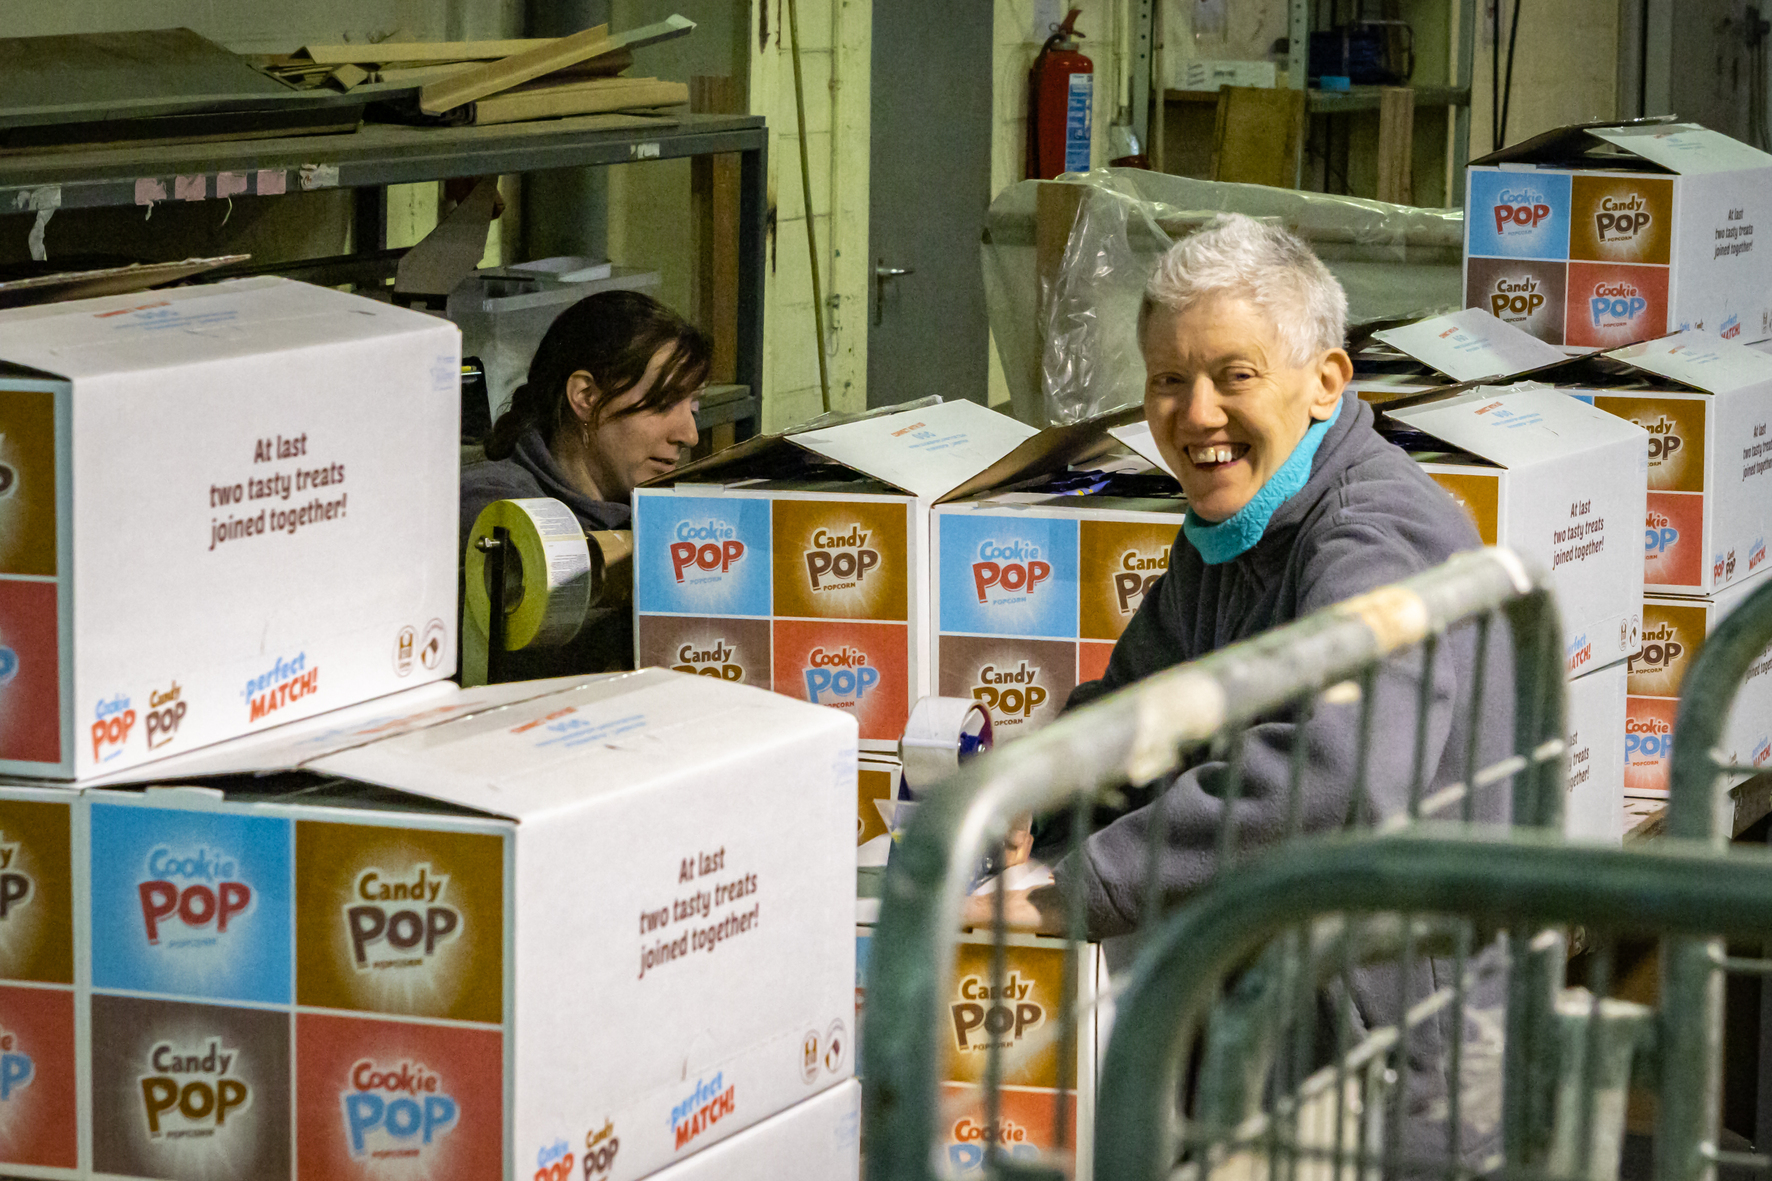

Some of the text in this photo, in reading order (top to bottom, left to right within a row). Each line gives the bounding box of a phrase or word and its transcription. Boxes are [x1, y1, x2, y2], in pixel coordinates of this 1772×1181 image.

[1499, 189, 1543, 205] Cookie
[1602, 195, 1643, 212] Candy
[1494, 204, 1550, 235] POP
[1595, 212, 1650, 242] POP
[1725, 226, 1738, 240] tasty
[1739, 224, 1753, 236] treats
[1714, 242, 1730, 260] joined
[1497, 277, 1537, 293] Candy
[1595, 284, 1637, 298] Cookie
[1491, 293, 1545, 319] POP
[1590, 297, 1646, 327] POP
[254, 432, 307, 463] At last
[1648, 436, 1680, 460] OP
[210, 462, 345, 508] two tasty treats
[208, 493, 347, 551] joined together!
[1570, 499, 1591, 518] At last
[677, 521, 733, 541] Cookie
[814, 526, 867, 549] Candy
[1554, 516, 1604, 545] two tasty treats
[1645, 528, 1678, 552] OP
[670, 540, 744, 583] POP
[979, 541, 1040, 563] Cookie
[1123, 549, 1170, 572] Cand
[1552, 535, 1604, 571] joined together!
[690, 576, 722, 585] POPCORN
[806, 550, 879, 591] POP
[972, 561, 1050, 604] POP
[823, 582, 856, 591] POPCORN
[992, 597, 1027, 606] POPCORN
[1642, 624, 1673, 641] andy
[679, 641, 732, 664] Candy
[809, 648, 866, 668] Cookie
[245, 651, 306, 704] perfect
[805, 667, 878, 704] POP
[981, 663, 1036, 685] Candy
[1636, 667, 1663, 675] POPCORN
[249, 667, 318, 723] MATCH!
[91, 709, 136, 763] POP
[146, 701, 187, 751] POP
[994, 718, 1023, 726] OPCORN
[1626, 719, 1669, 734] Cookie
[150, 848, 236, 881] Cookie
[679, 845, 725, 884] At last
[359, 868, 441, 902] Candy
[139, 879, 251, 945] POP
[640, 872, 758, 935] two tasty treats
[348, 905, 458, 967] POP
[637, 901, 759, 980] joined together!
[952, 1003, 1041, 1049] POP
[152, 1041, 232, 1075] Candy
[353, 1062, 437, 1096] Cookie
[141, 1077, 247, 1136] POP
[675, 1084, 735, 1151] MATCH!
[346, 1092, 455, 1155] POP
